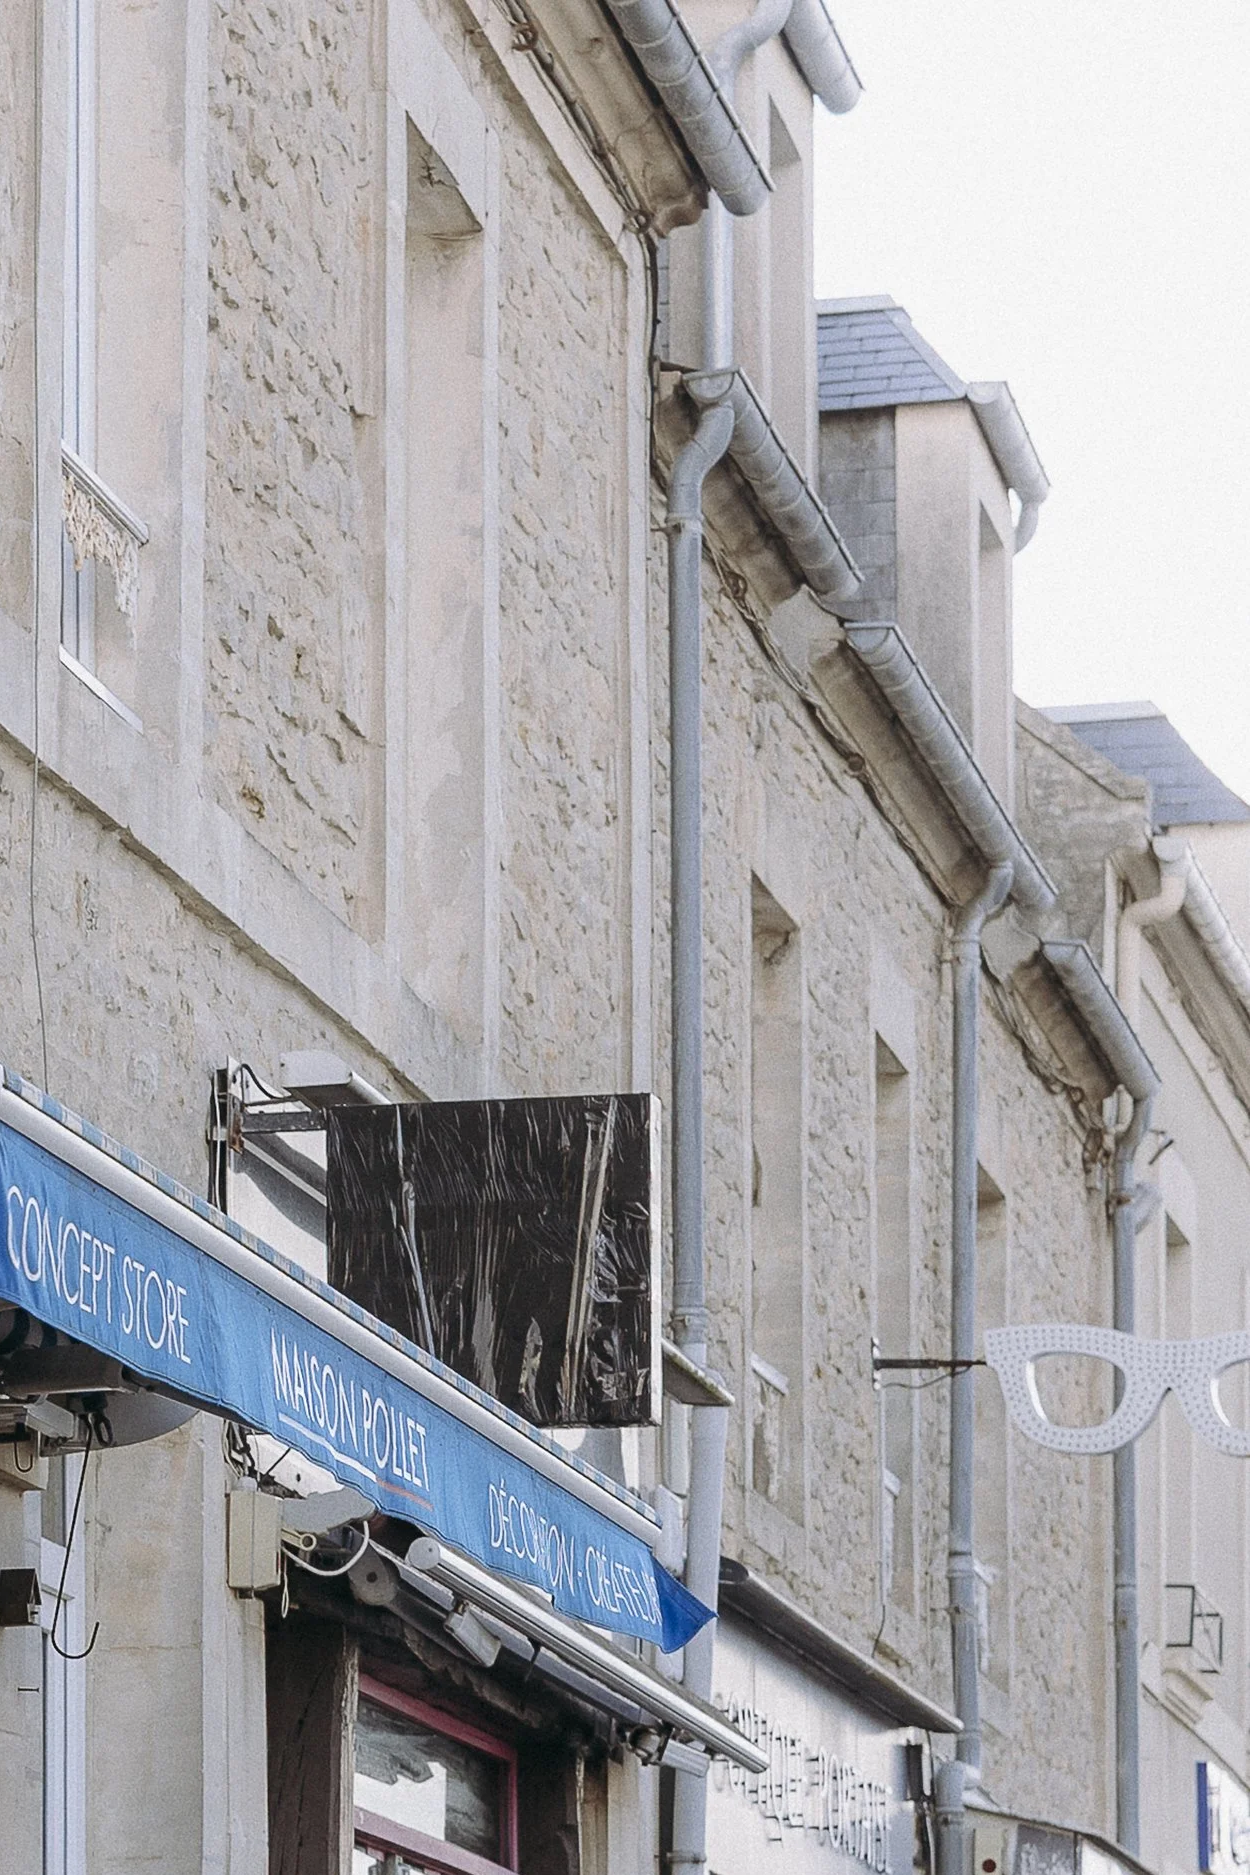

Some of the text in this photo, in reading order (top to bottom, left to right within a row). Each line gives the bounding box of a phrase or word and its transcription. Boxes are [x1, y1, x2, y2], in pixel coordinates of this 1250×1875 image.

[7, 1185, 192, 1365] CONCEPT STORE
[271, 1326, 430, 1492] MAISON POLLET
